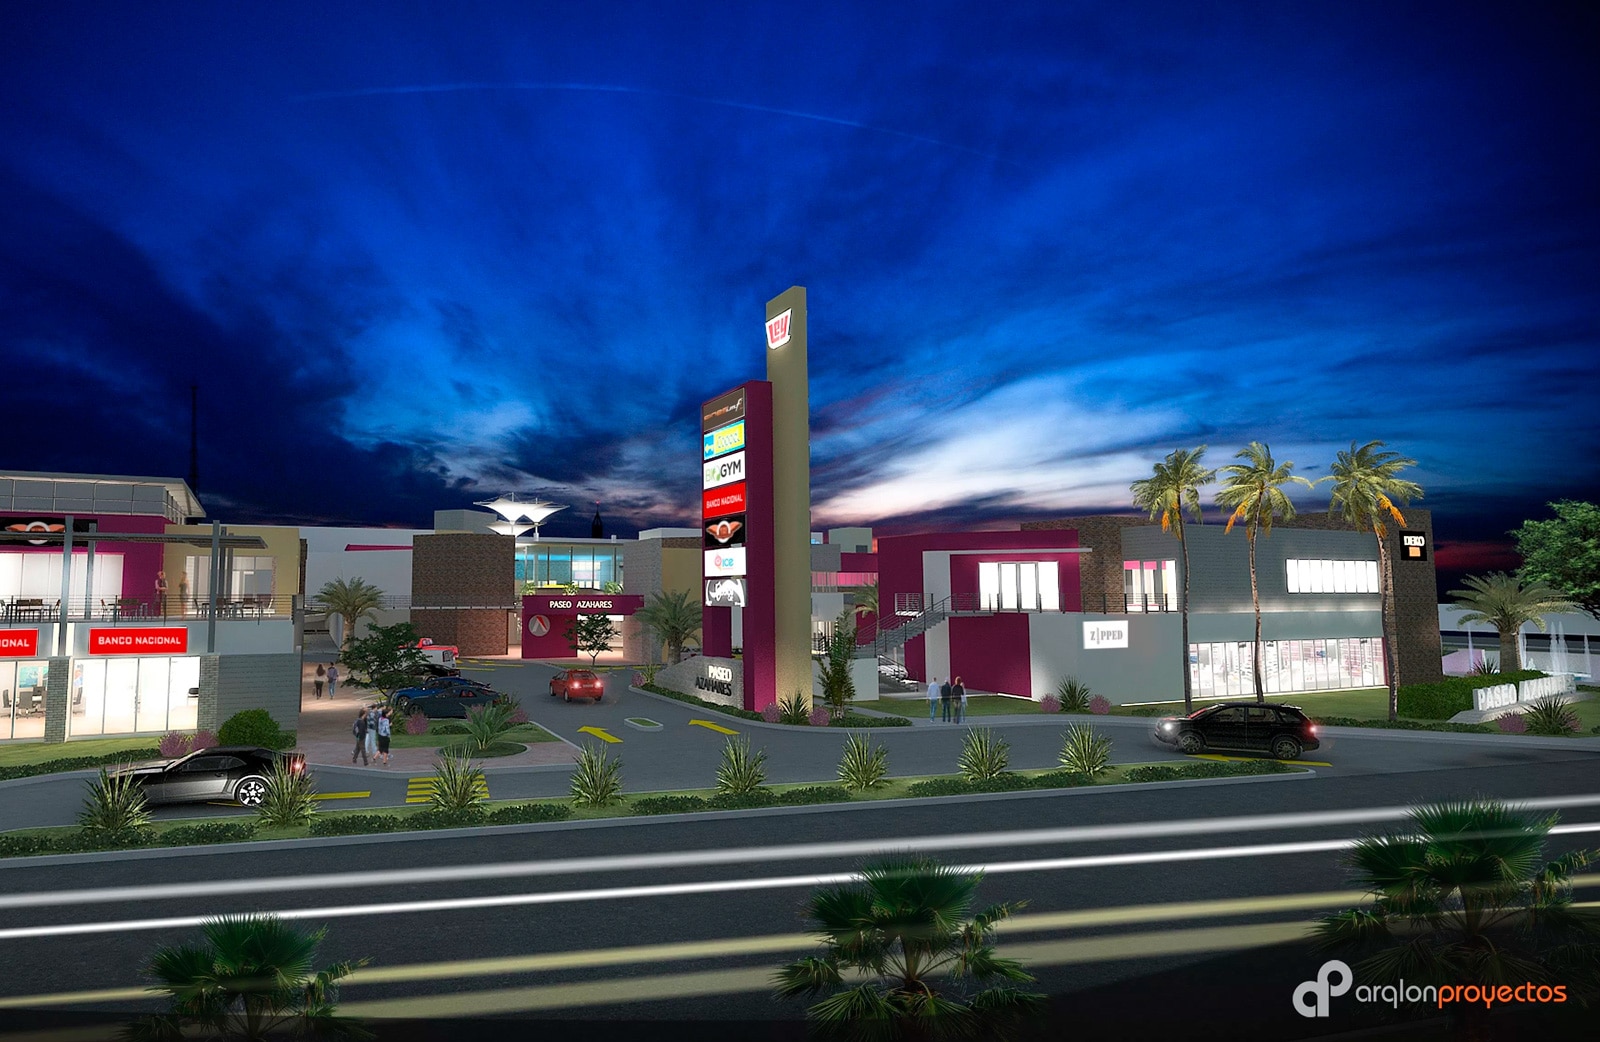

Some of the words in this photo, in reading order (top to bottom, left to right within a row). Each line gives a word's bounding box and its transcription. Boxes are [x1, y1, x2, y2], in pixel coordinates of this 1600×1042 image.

[706, 498, 720, 509] BANCO
[721, 494, 743, 506] NACIONAL
[549, 601, 572, 609] PASEO
[577, 601, 613, 609] AZAHARES
[98, 636, 132, 645] BANCO
[135, 636, 181, 645] NACIONAL
[1090, 627, 1123, 645] ZIPPED
[708, 665, 732, 682] PASEO
[695, 676, 732, 696] AZAHARES
[1475, 684, 1517, 711] PASEO
